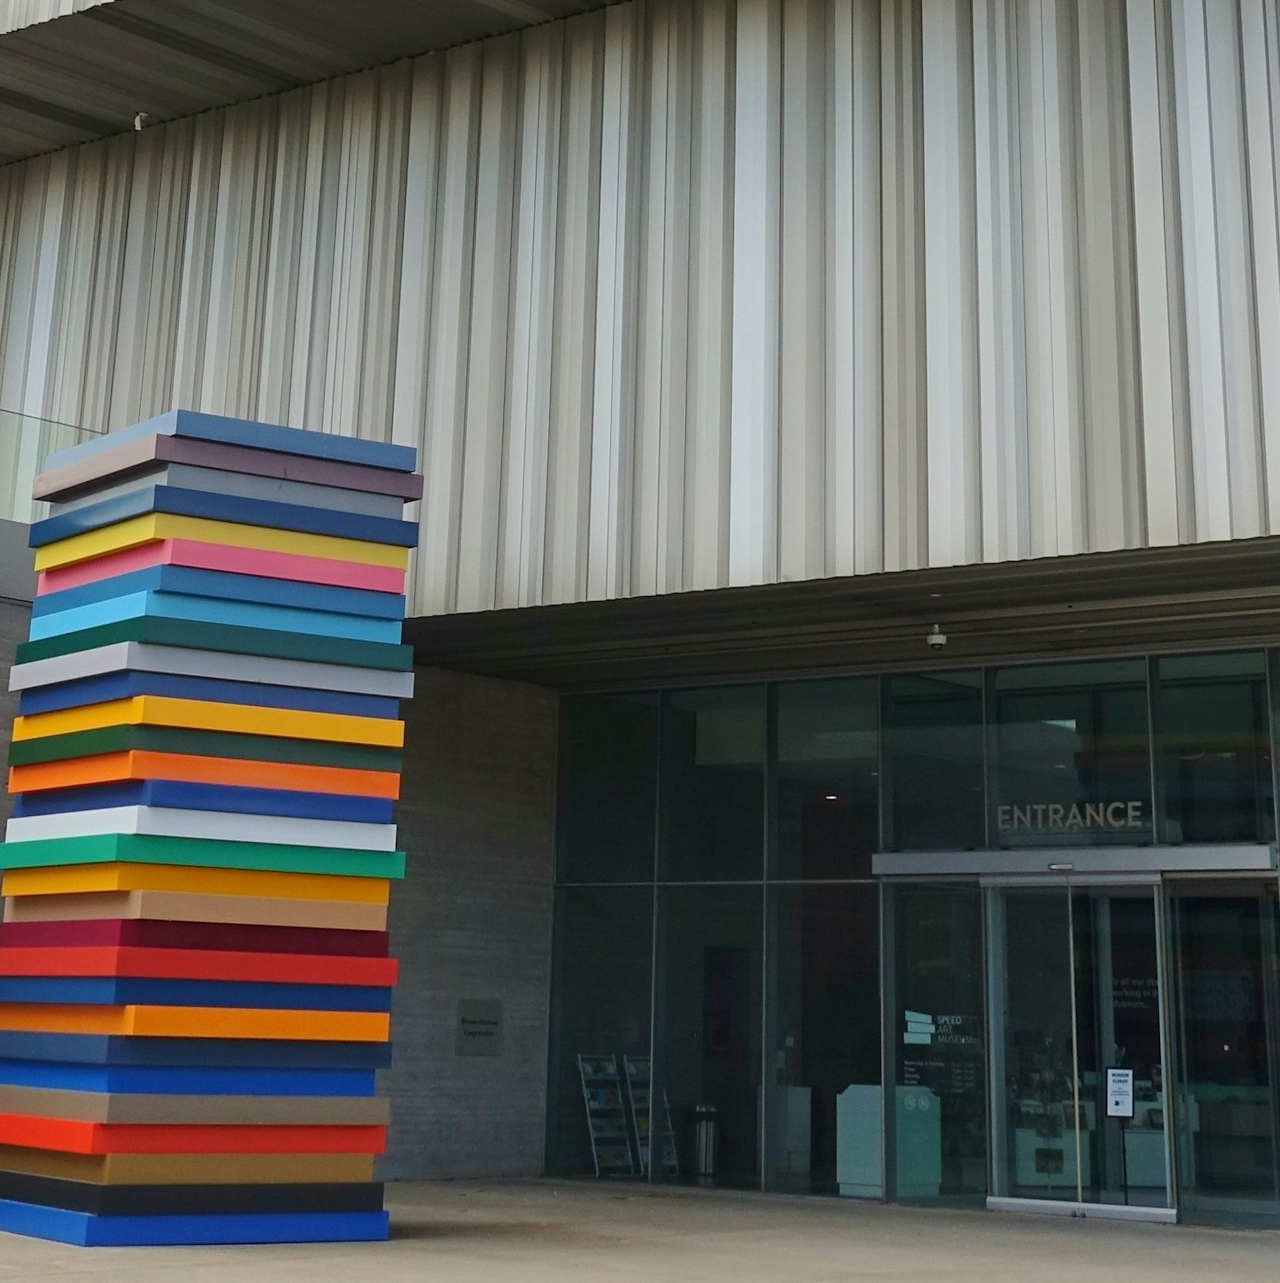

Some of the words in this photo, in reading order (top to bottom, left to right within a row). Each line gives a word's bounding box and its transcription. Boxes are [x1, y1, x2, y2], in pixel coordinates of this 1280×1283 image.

[997, 801, 1142, 830] ENTRANCE
[937, 1015, 962, 1025] SPEED
[937, 1025, 953, 1034] ART
